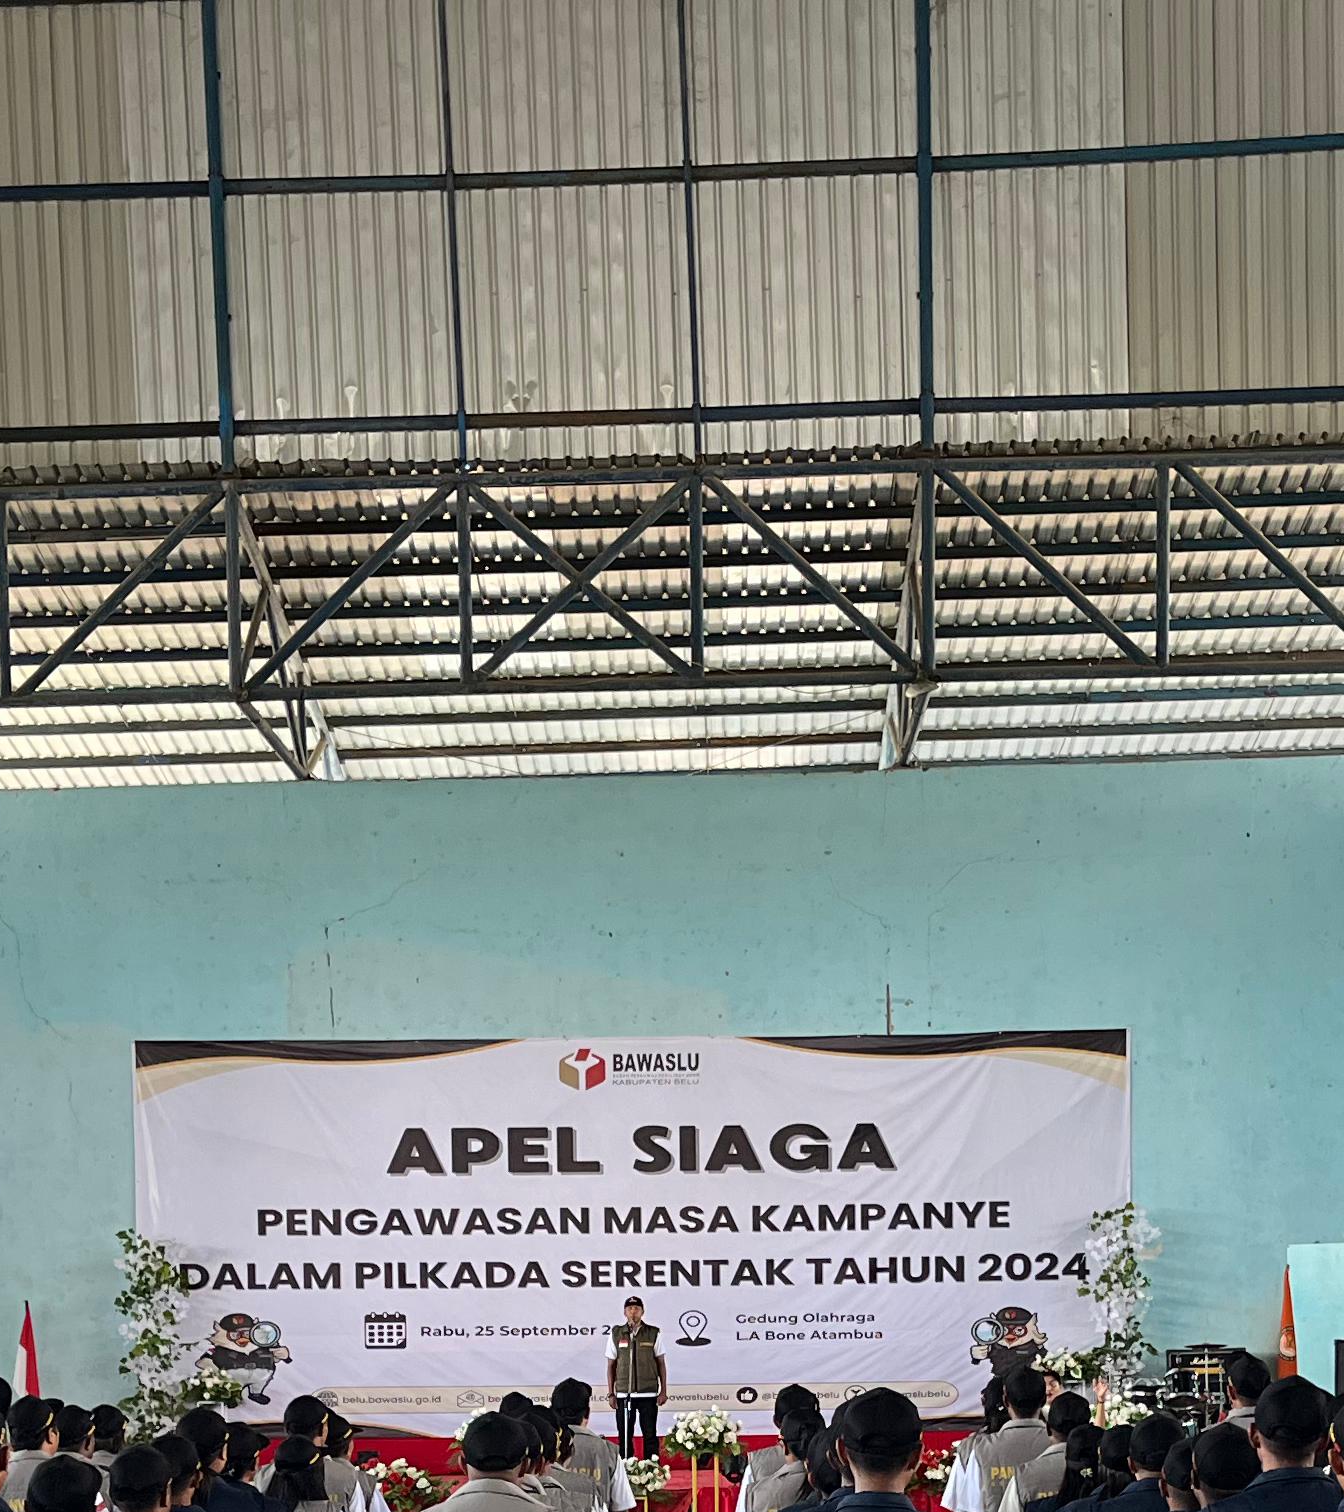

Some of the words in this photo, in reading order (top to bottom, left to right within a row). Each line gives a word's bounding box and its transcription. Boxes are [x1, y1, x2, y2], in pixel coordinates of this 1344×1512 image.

[612, 1052, 700, 1072] BAWASLU
[387, 1126, 603, 1176] APEL
[632, 1123, 897, 1174] SIAGA
[257, 1207, 590, 1236] PENGAWASAN
[604, 1205, 738, 1234] MASA
[752, 1201, 1010, 1232] KAMPANYE
[180, 1263, 342, 1291] DALAM
[355, 1261, 549, 1290] PILKADA
[561, 1258, 795, 1288] SERENTAK
[805, 1256, 965, 1285] TAHUN
[978, 1253, 1090, 1282] 2024
[735, 1314, 798, 1325] Gedung
[803, 1312, 875, 1324] Olahraga
[421, 1326, 470, 1338] Rabu,
[475, 1326, 494, 1336] 25
[500, 1324, 597, 1338] September
[765, 1331, 806, 1341] Bone
[810, 1329, 883, 1340] Atambua
